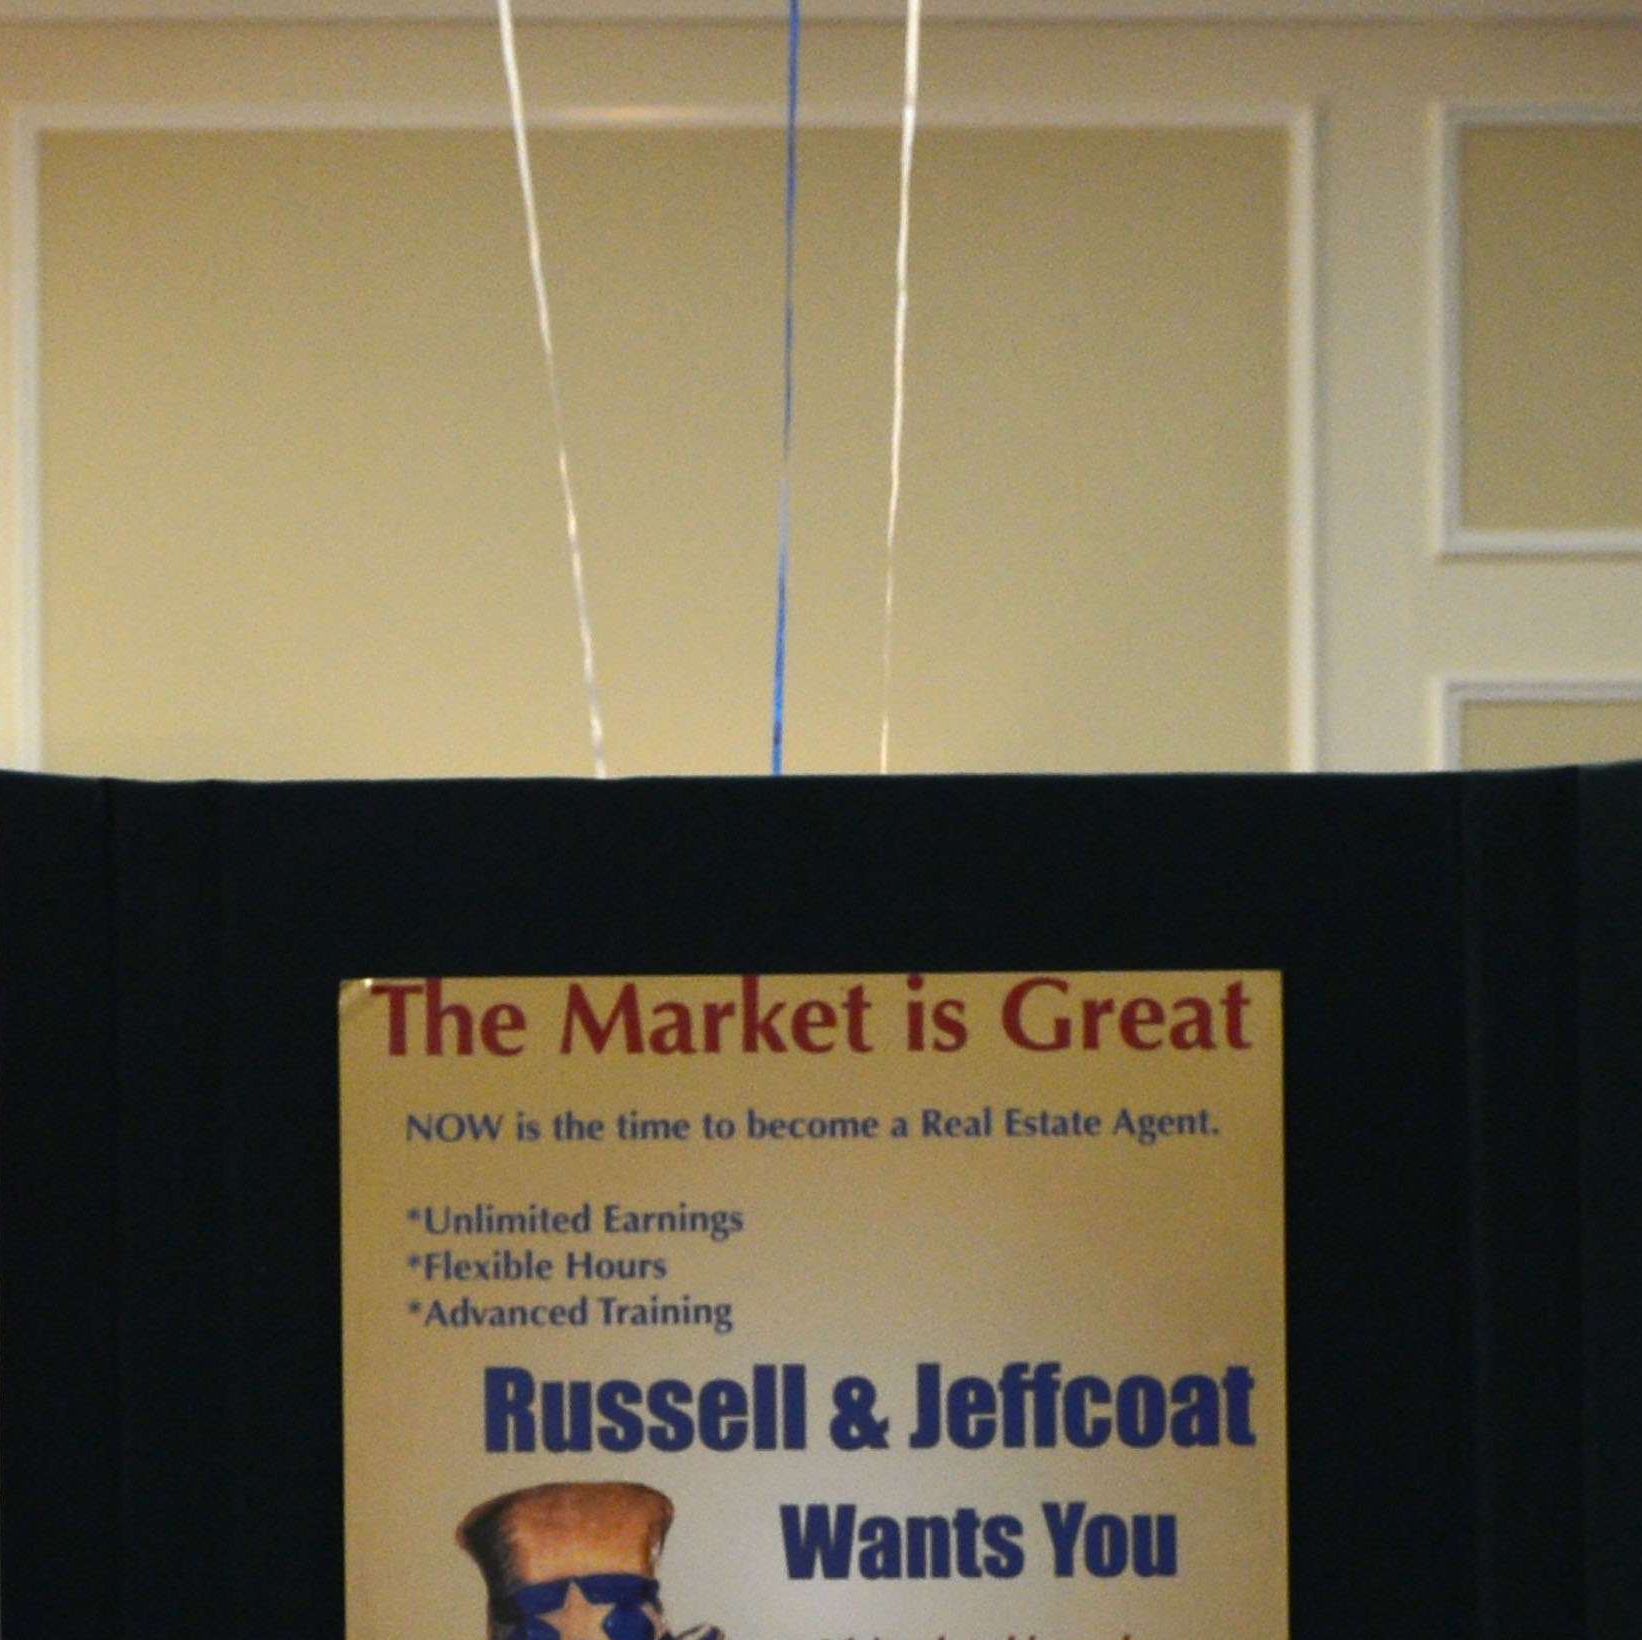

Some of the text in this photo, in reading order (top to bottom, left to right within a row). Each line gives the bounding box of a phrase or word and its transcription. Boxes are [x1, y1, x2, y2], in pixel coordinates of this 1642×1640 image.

[370, 973, 1251, 1056] The Market is Great
[407, 1106, 1219, 1145] NOW is the time to become a Real Estate Agent.
[604, 1202, 743, 1242] Earnings
[567, 1251, 667, 1279] Hours
[597, 1295, 733, 1333] Training
[484, 1362, 1257, 1454] Russell & Jeffcoat
[780, 1502, 1178, 1580] Wants You
